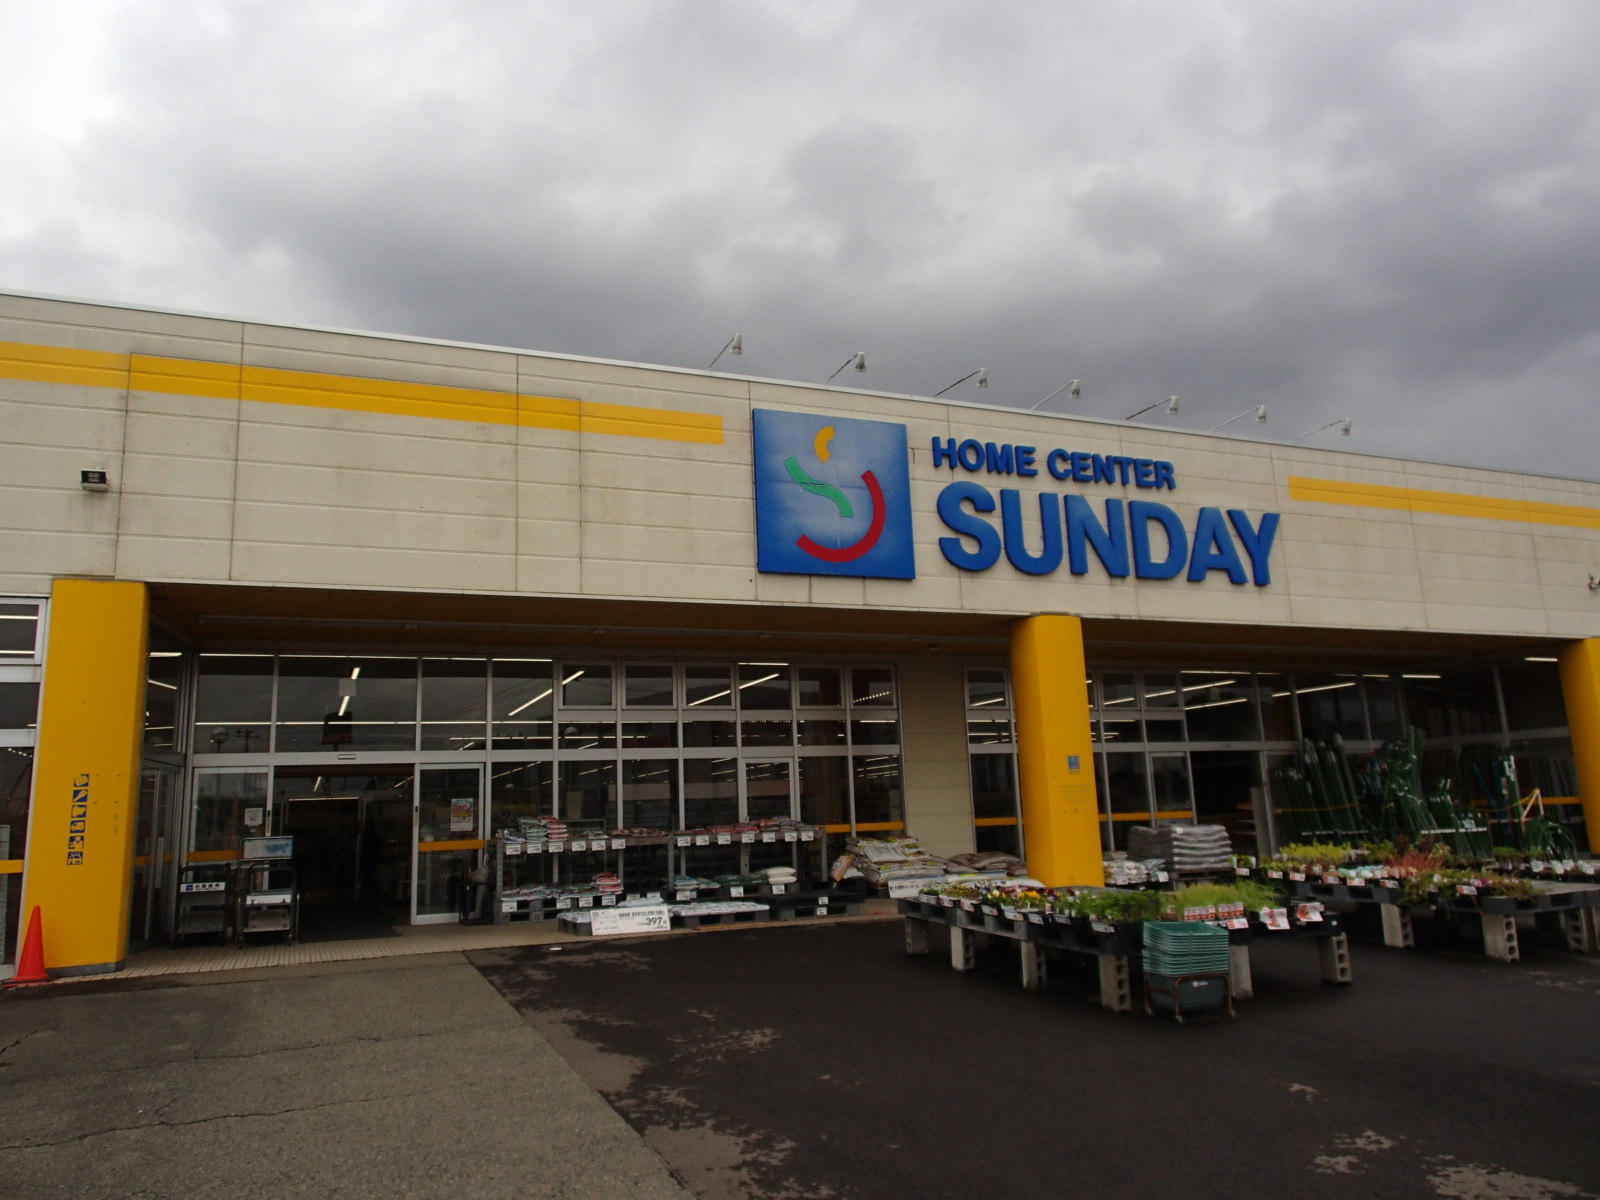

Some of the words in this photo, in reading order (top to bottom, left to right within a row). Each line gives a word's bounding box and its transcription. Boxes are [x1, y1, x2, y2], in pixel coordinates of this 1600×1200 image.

[932, 436, 1038, 476] HOME
[1047, 448, 1177, 490] CENTER
[936, 481, 1281, 586] SUNDAY
[646, 917, 662, 925] 397
